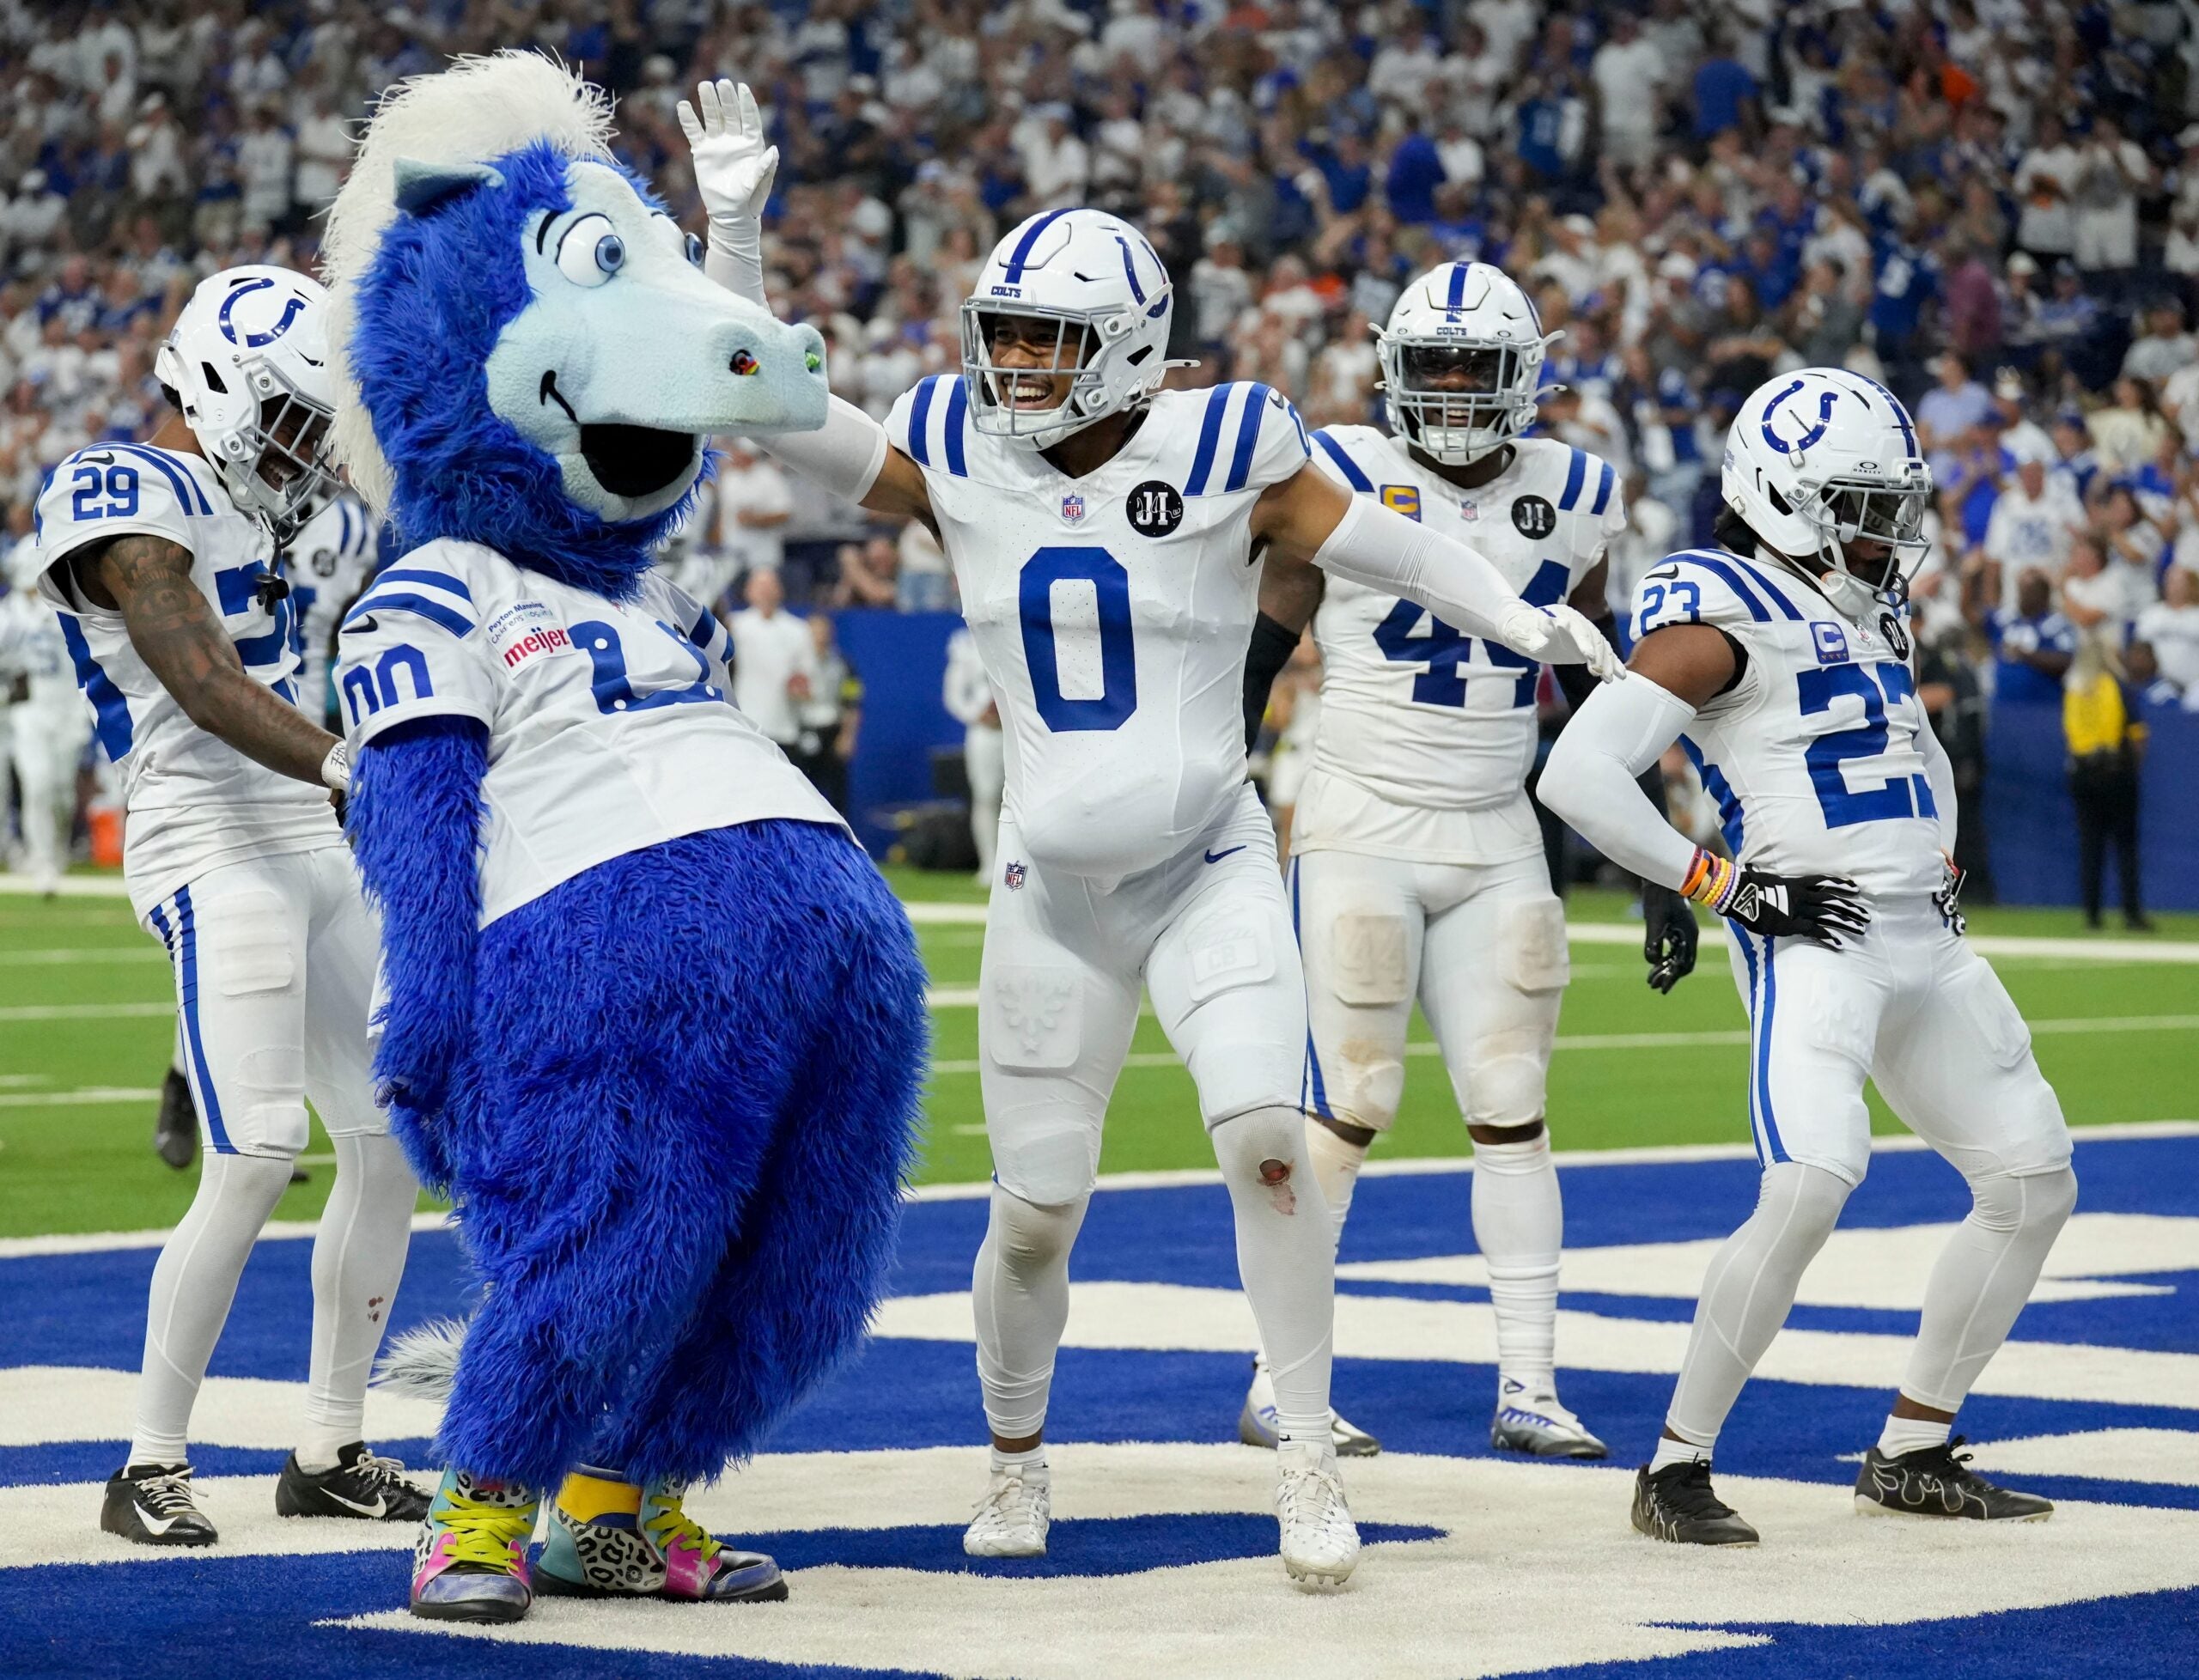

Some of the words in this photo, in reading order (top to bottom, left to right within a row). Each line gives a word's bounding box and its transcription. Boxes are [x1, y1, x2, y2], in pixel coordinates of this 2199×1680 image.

[990, 286, 1021, 298] COLTS
[1436, 327, 1467, 336] COLTS
[72, 466, 138, 521] 29
[1383, 486, 1418, 514] C
[1065, 506, 1081, 516] NFL
[488, 610, 514, 633] Peyton
[514, 602, 545, 612] Manning
[1640, 581, 1701, 636] 23
[504, 627, 569, 667] meijer
[1019, 546, 1137, 733] 0
[1814, 624, 1845, 653] C
[1007, 873, 1021, 886] NFL
